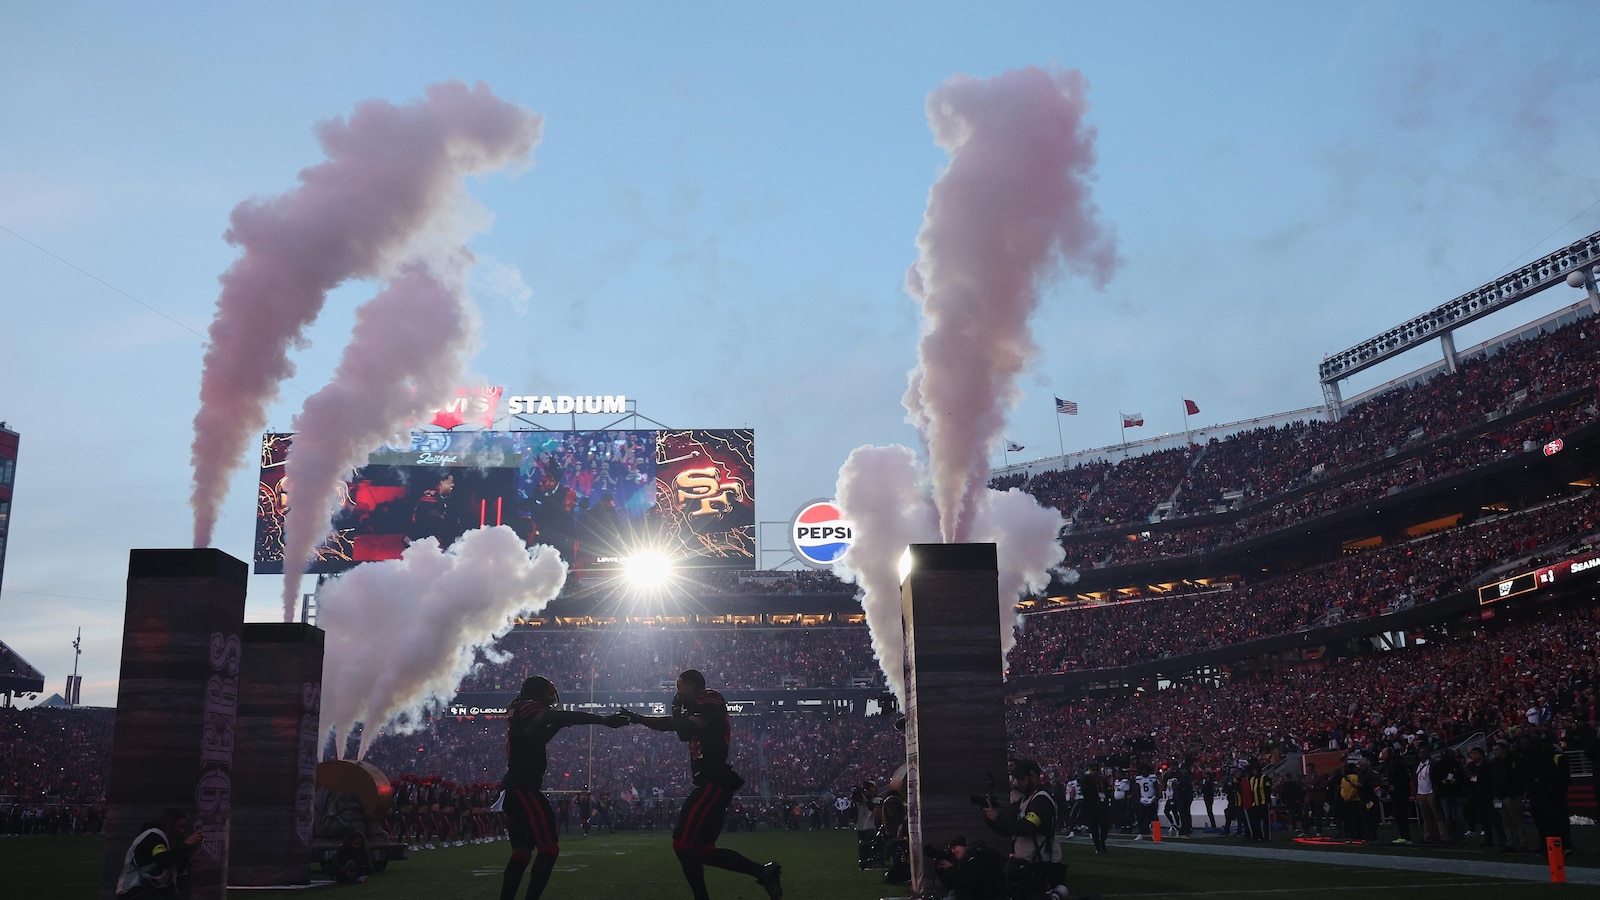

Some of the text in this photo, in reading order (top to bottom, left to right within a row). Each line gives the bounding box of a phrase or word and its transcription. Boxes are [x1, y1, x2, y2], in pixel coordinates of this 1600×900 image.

[508, 395, 626, 414] STADIUM
[416, 452, 457, 467] Faithful
[797, 526, 852, 539] PEPSI
[653, 705, 664, 713] 25
[195, 631, 242, 864] 49ERS
[1143, 782, 1149, 792] 6
